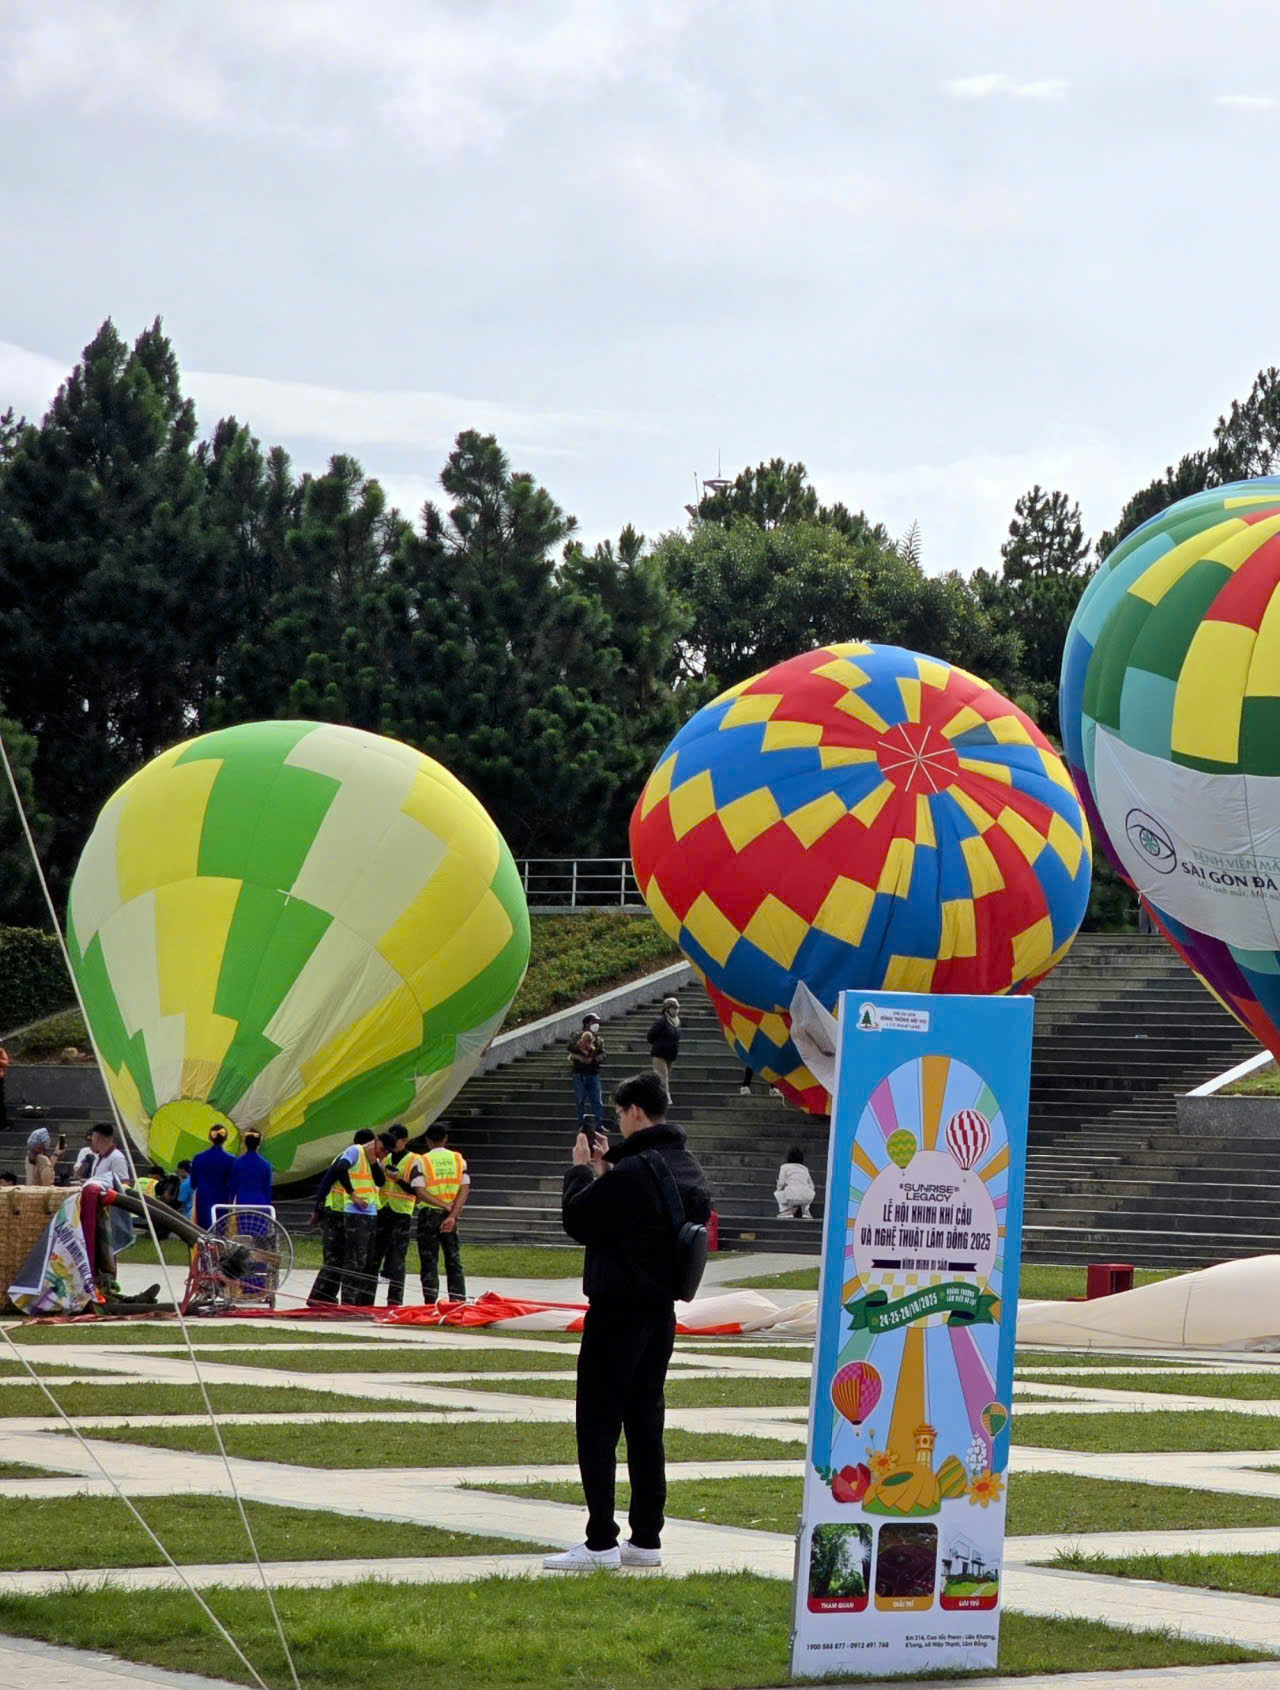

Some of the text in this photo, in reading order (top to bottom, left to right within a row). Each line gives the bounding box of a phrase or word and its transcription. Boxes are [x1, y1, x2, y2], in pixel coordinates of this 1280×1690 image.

[1181, 860, 1207, 880] SÀI
[1208, 870, 1249, 888] GÒN
[1251, 871, 1279, 892] ĐÀ
[904, 1183, 954, 1193] SUNRISE
[906, 1192, 952, 1202] LEGACY
[883, 1199, 972, 1227] LỄ HỘI KHINH KHÍ CẦU
[861, 1224, 991, 1252] VÀ NGHỆ THUẬT LÂM ĐỒNG 2025
[880, 1293, 937, 1327] 24-25-26/10/2025
